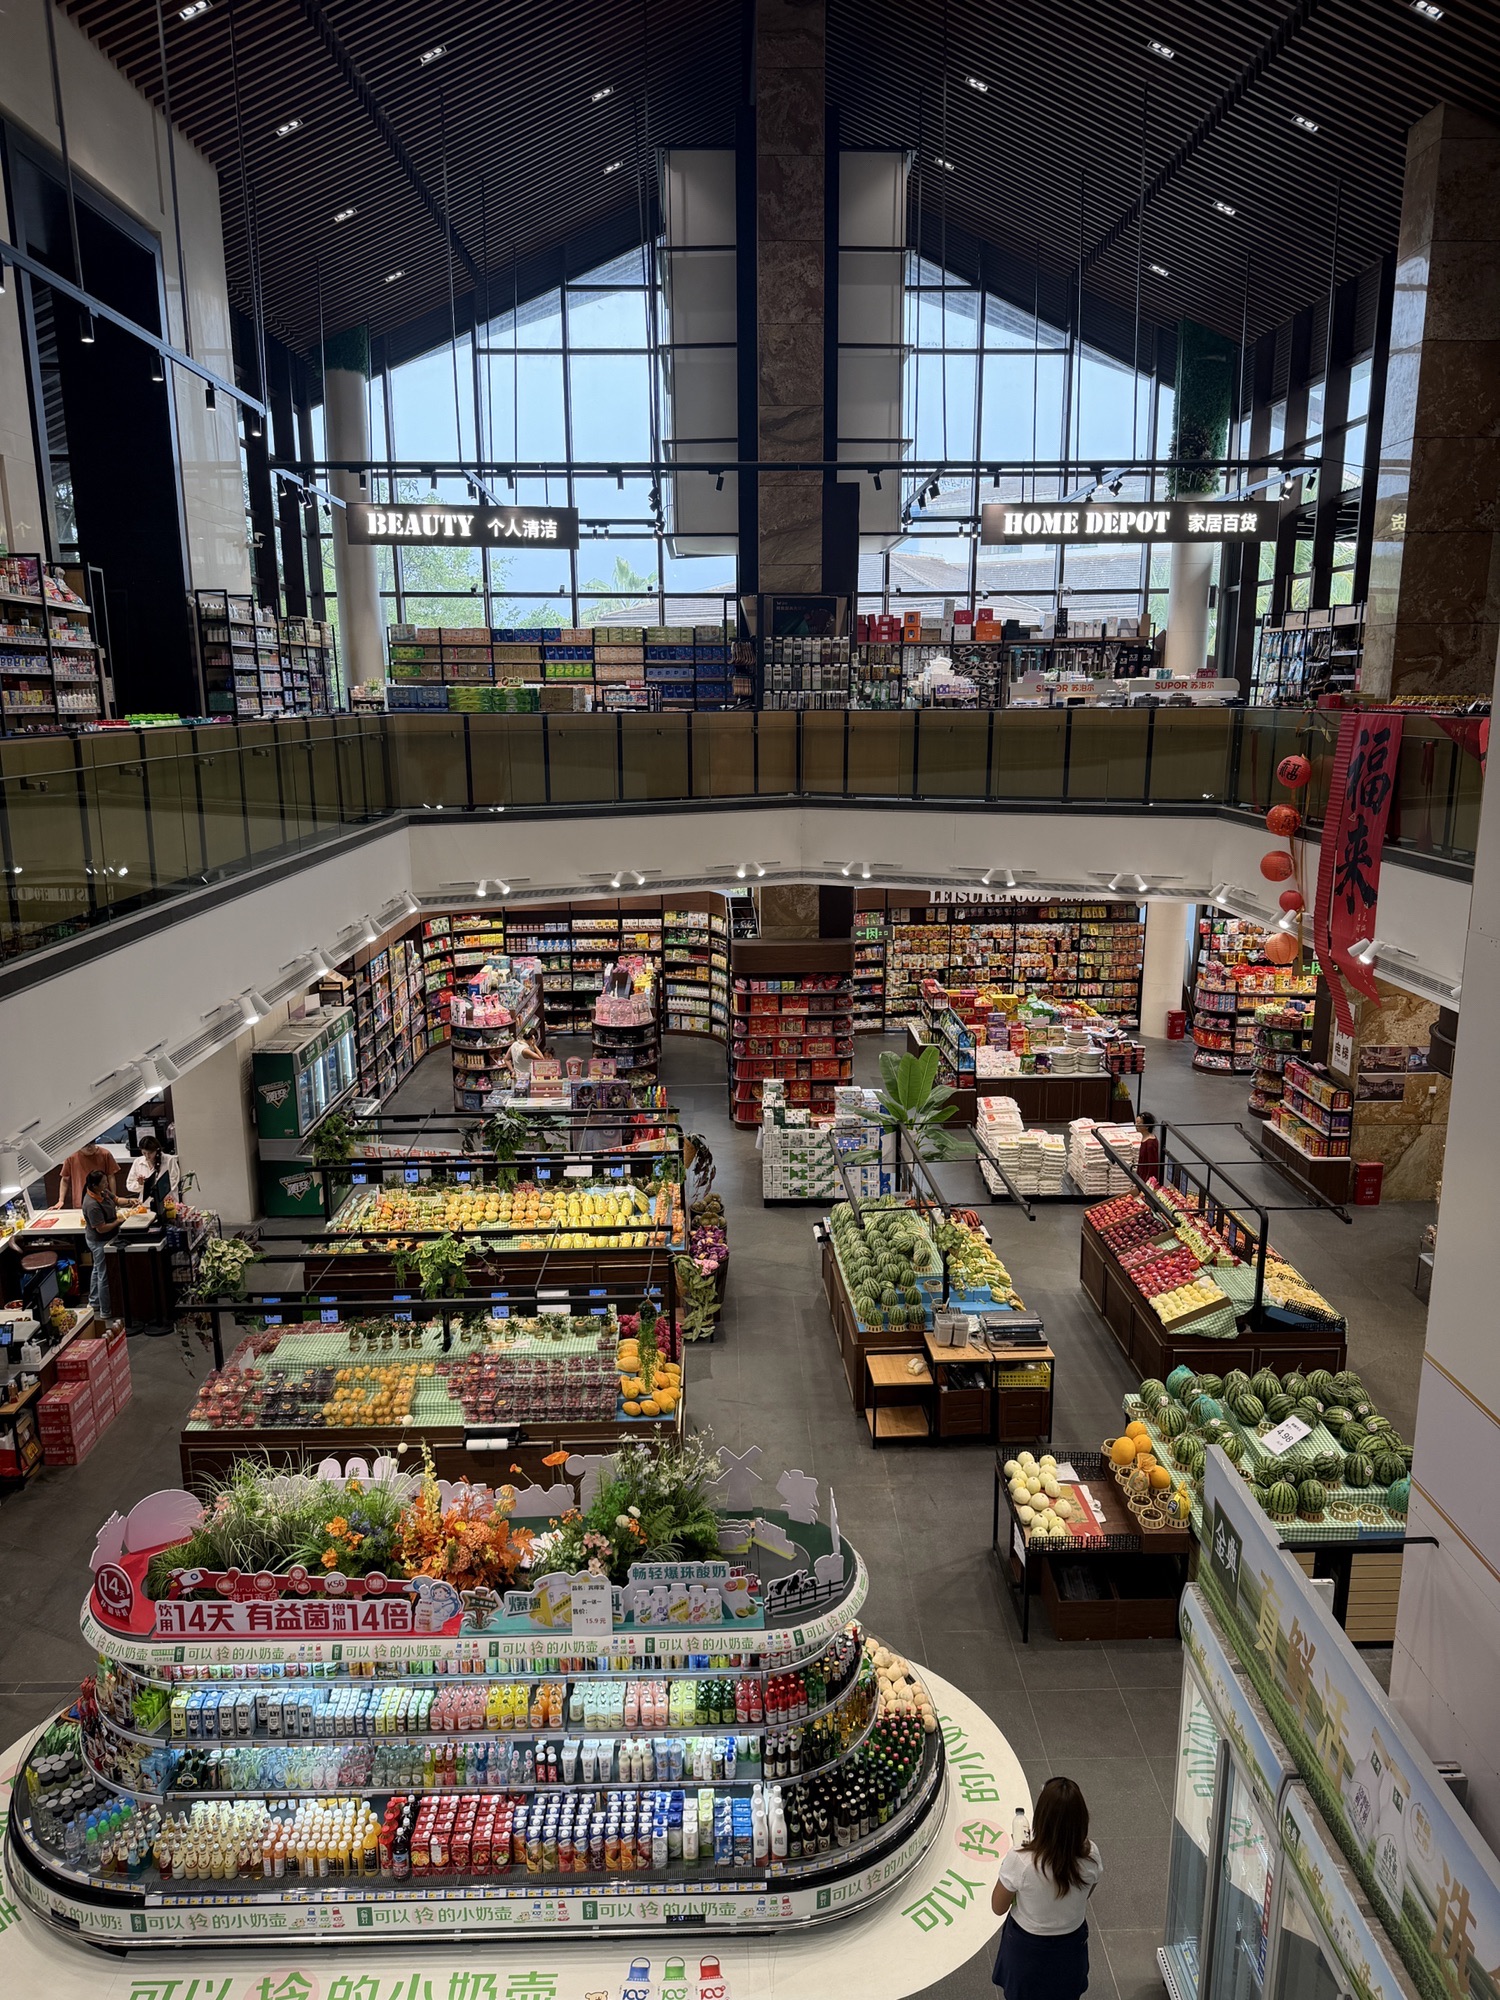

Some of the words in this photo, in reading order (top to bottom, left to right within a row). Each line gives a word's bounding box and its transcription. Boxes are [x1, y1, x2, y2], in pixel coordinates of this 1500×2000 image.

[367, 512, 474, 537] BEAUTY
[487, 518, 558, 539] 个人清洁
[1003, 512, 1079, 535] HOME
[1084, 511, 1170, 535] DEPOT
[1188, 512, 1258, 534] 家居百货
[1154, 681, 1188, 690] SUPOR
[1190, 681, 1215, 690] 苏泊尔
[1277, 1429, 1294, 1443] 4.98
[1214, 1519, 1239, 1583] 金典
[632, 1565, 727, 1581] 畅轻爆珠酸奶
[327, 1579, 345, 1589] K56
[345, 1644, 442, 1659] 可以拎的小奶壶
[502, 1638, 598, 1656] 可以拎的小奶壶
[659, 1636, 754, 1652] 可以拎的小奶壶
[188, 1646, 285, 1661] 可以拎的小奶壶
[373, 1906, 513, 1924] 可以拎的小奶壶
[599, 1901, 737, 1918] 可以拎的小奶壶
[147, 1912, 288, 1931] 可以拎的小奶壶
